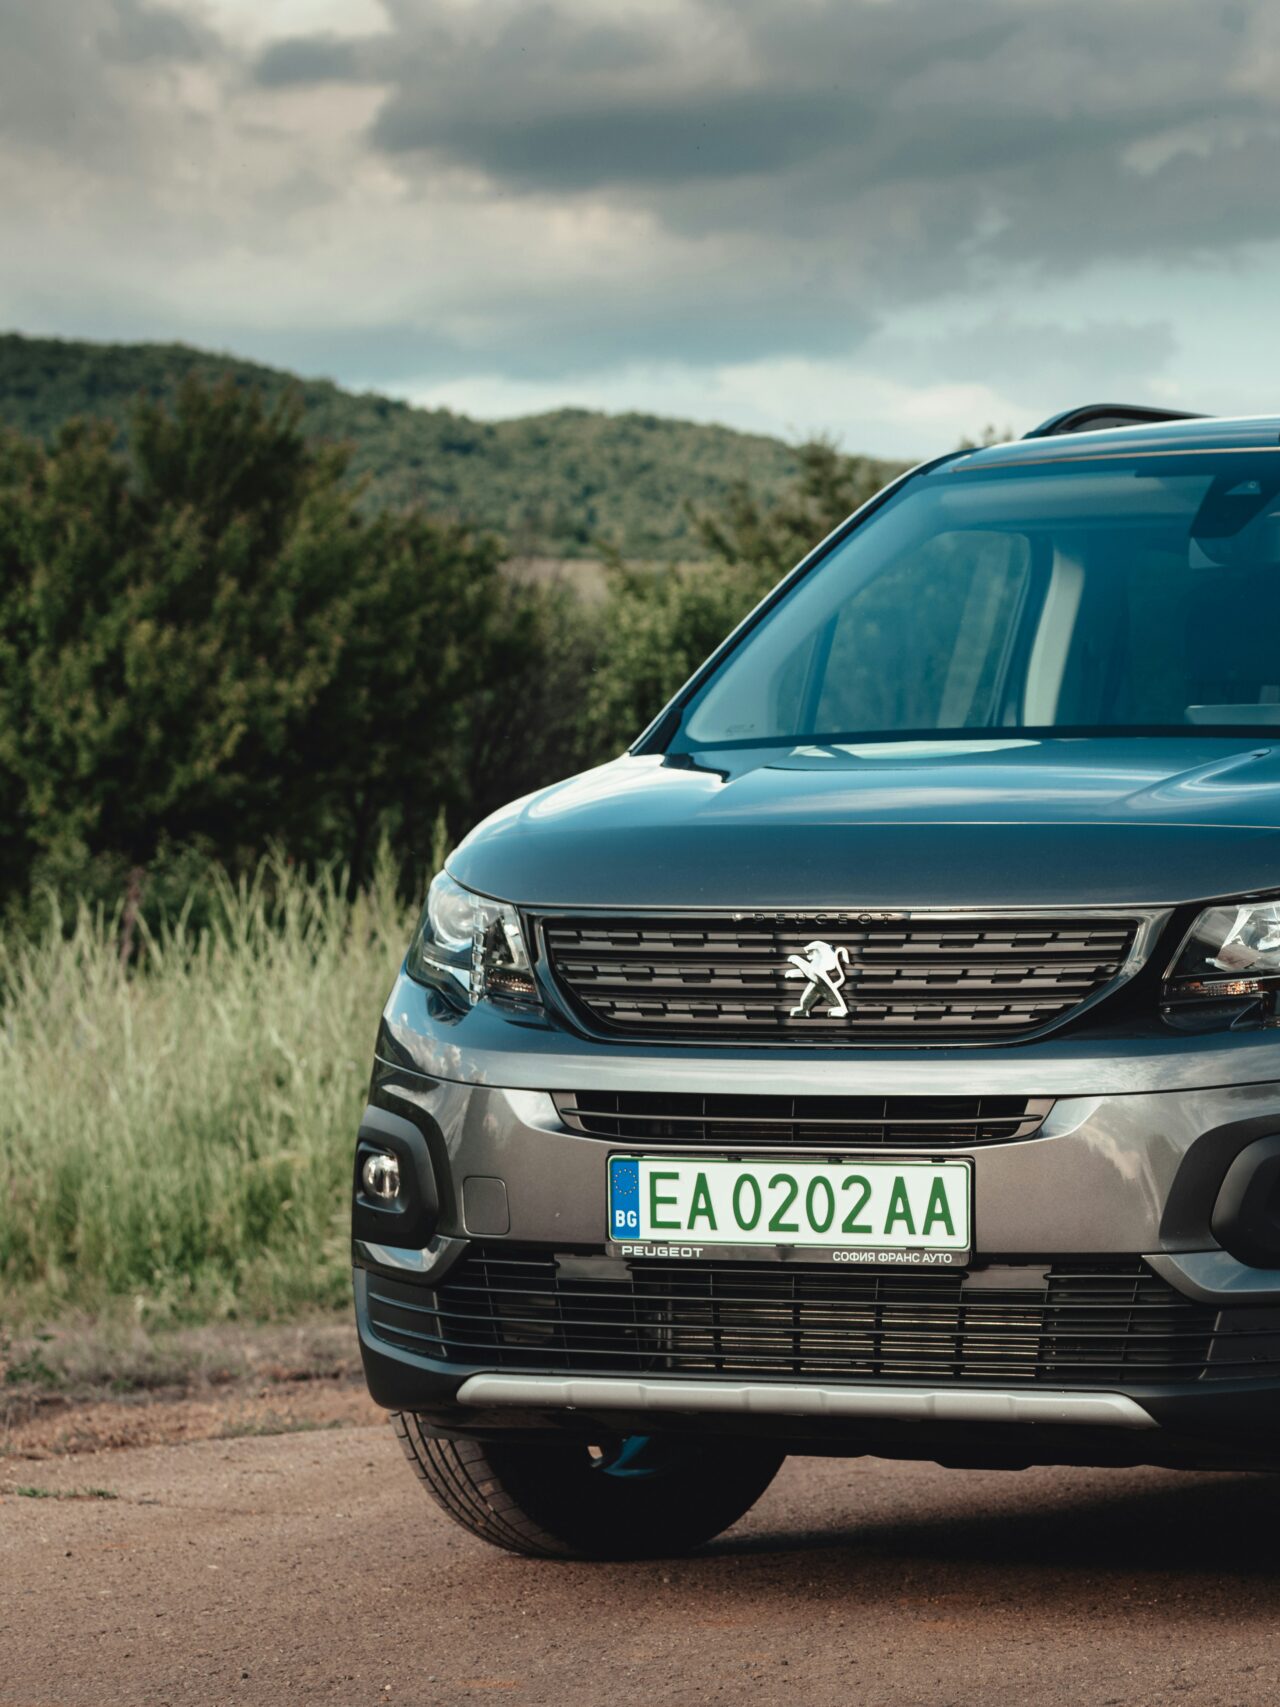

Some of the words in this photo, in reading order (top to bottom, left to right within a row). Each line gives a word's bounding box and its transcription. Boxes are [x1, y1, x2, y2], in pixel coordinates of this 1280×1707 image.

[648, 1171, 718, 1231] EA
[732, 1172, 873, 1234] 0202
[883, 1176, 956, 1236] AA
[615, 1209, 637, 1228] BG
[621, 1245, 704, 1258] PEUGEOT
[832, 1251, 876, 1262] СОФИЯ
[877, 1251, 921, 1263] ФРАНС
[922, 1253, 953, 1263] АУТО
